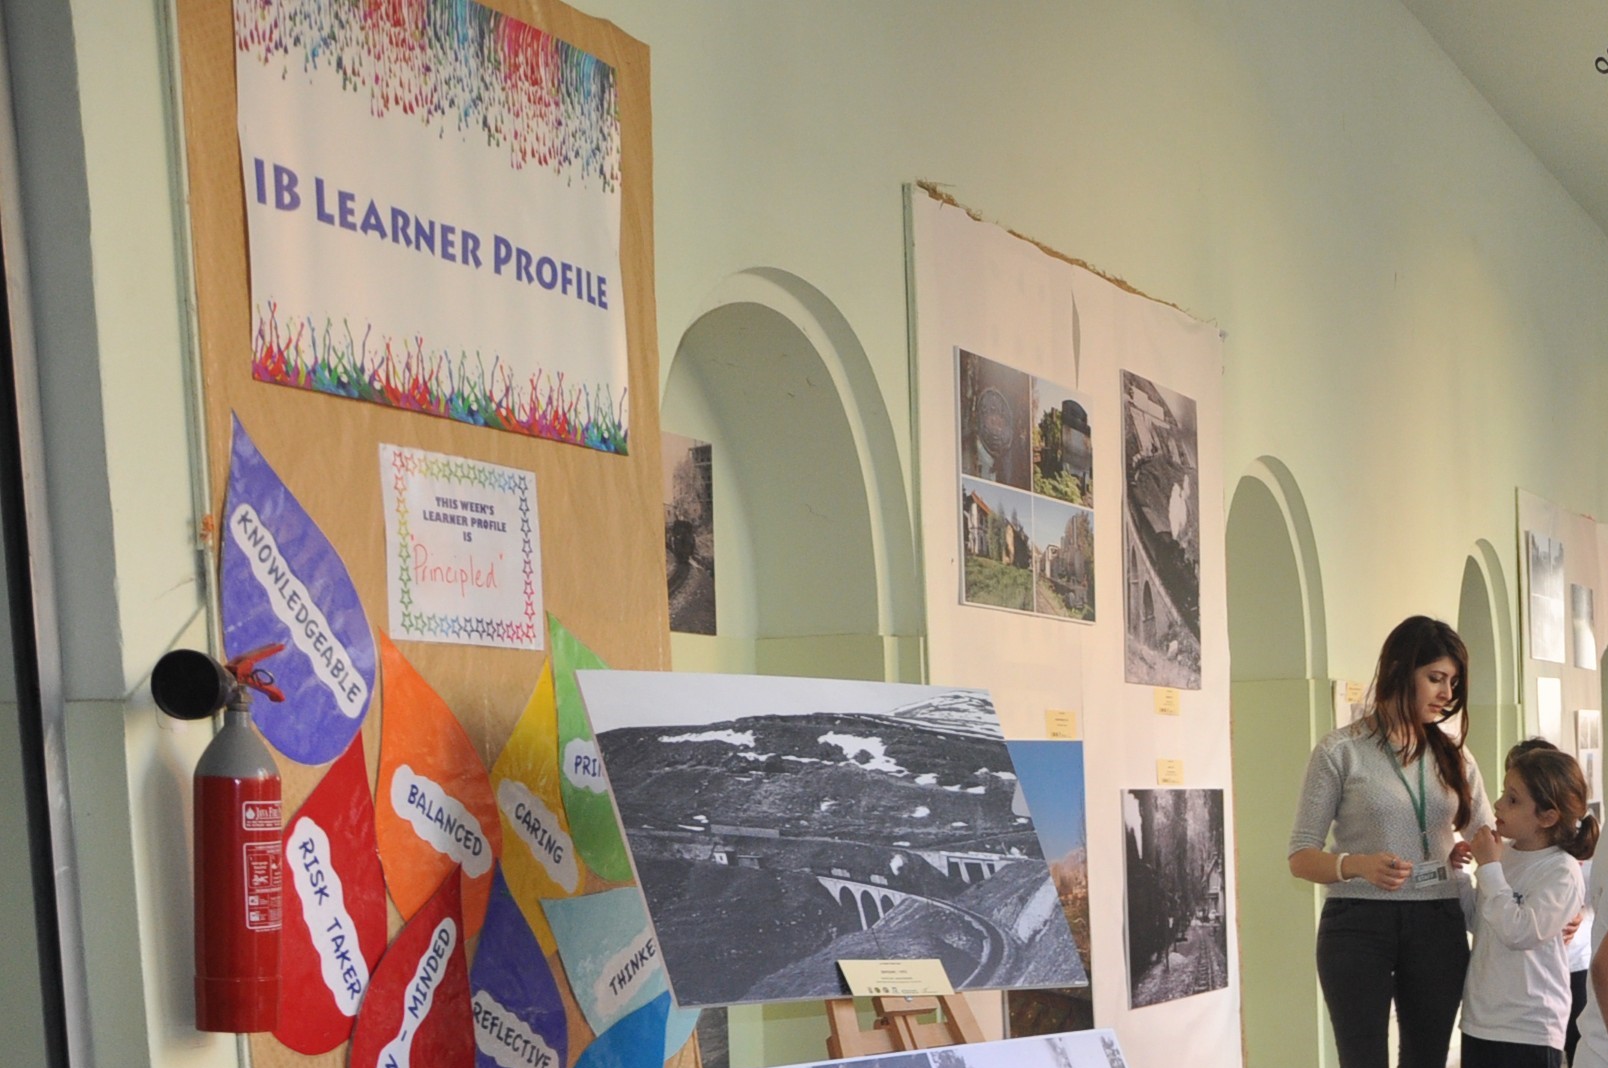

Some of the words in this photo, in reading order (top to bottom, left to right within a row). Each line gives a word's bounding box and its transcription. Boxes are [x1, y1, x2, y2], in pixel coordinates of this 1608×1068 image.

[254, 157, 301, 212] IB
[314, 176, 483, 270] LEARNER
[494, 234, 608, 310] PROFILE
[422, 509, 469, 527] LEARNER
[470, 517, 507, 533] PROFILE
[435, 496, 459, 510] THIS
[460, 500, 495, 516] WEEK'S
[462, 531, 473, 542] IS
[237, 510, 362, 704] KNOWLEDGEABLE
[407, 784, 483, 857] BALANCED
[515, 803, 564, 865] CARING
[298, 838, 330, 906] RISK
[326, 917, 362, 1000] TAKER
[408, 928, 451, 1019] MINDED
